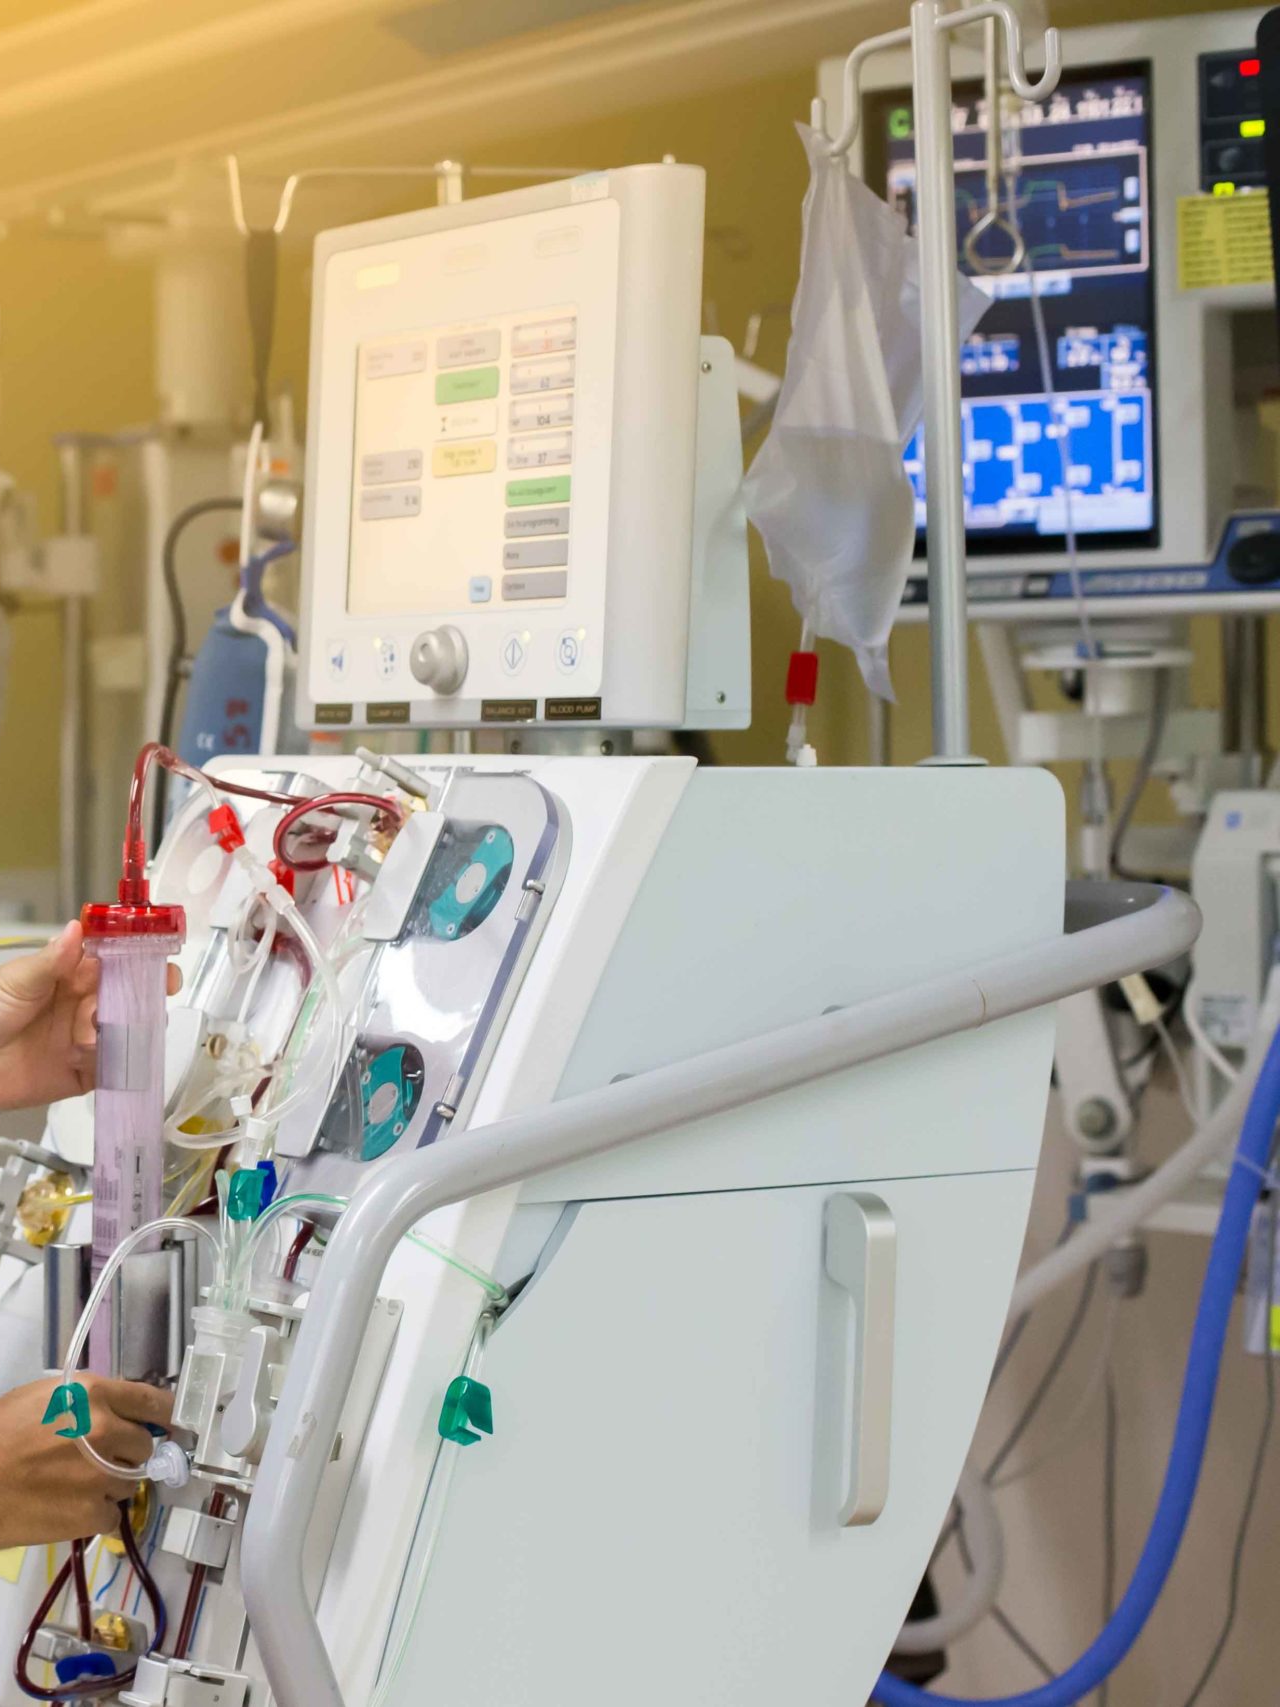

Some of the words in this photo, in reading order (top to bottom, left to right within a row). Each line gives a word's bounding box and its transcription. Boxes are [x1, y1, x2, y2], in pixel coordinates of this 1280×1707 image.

[536, 414, 551, 426] 104
[549, 703, 574, 714] BLOOD
[575, 703, 597, 713] PUMP
